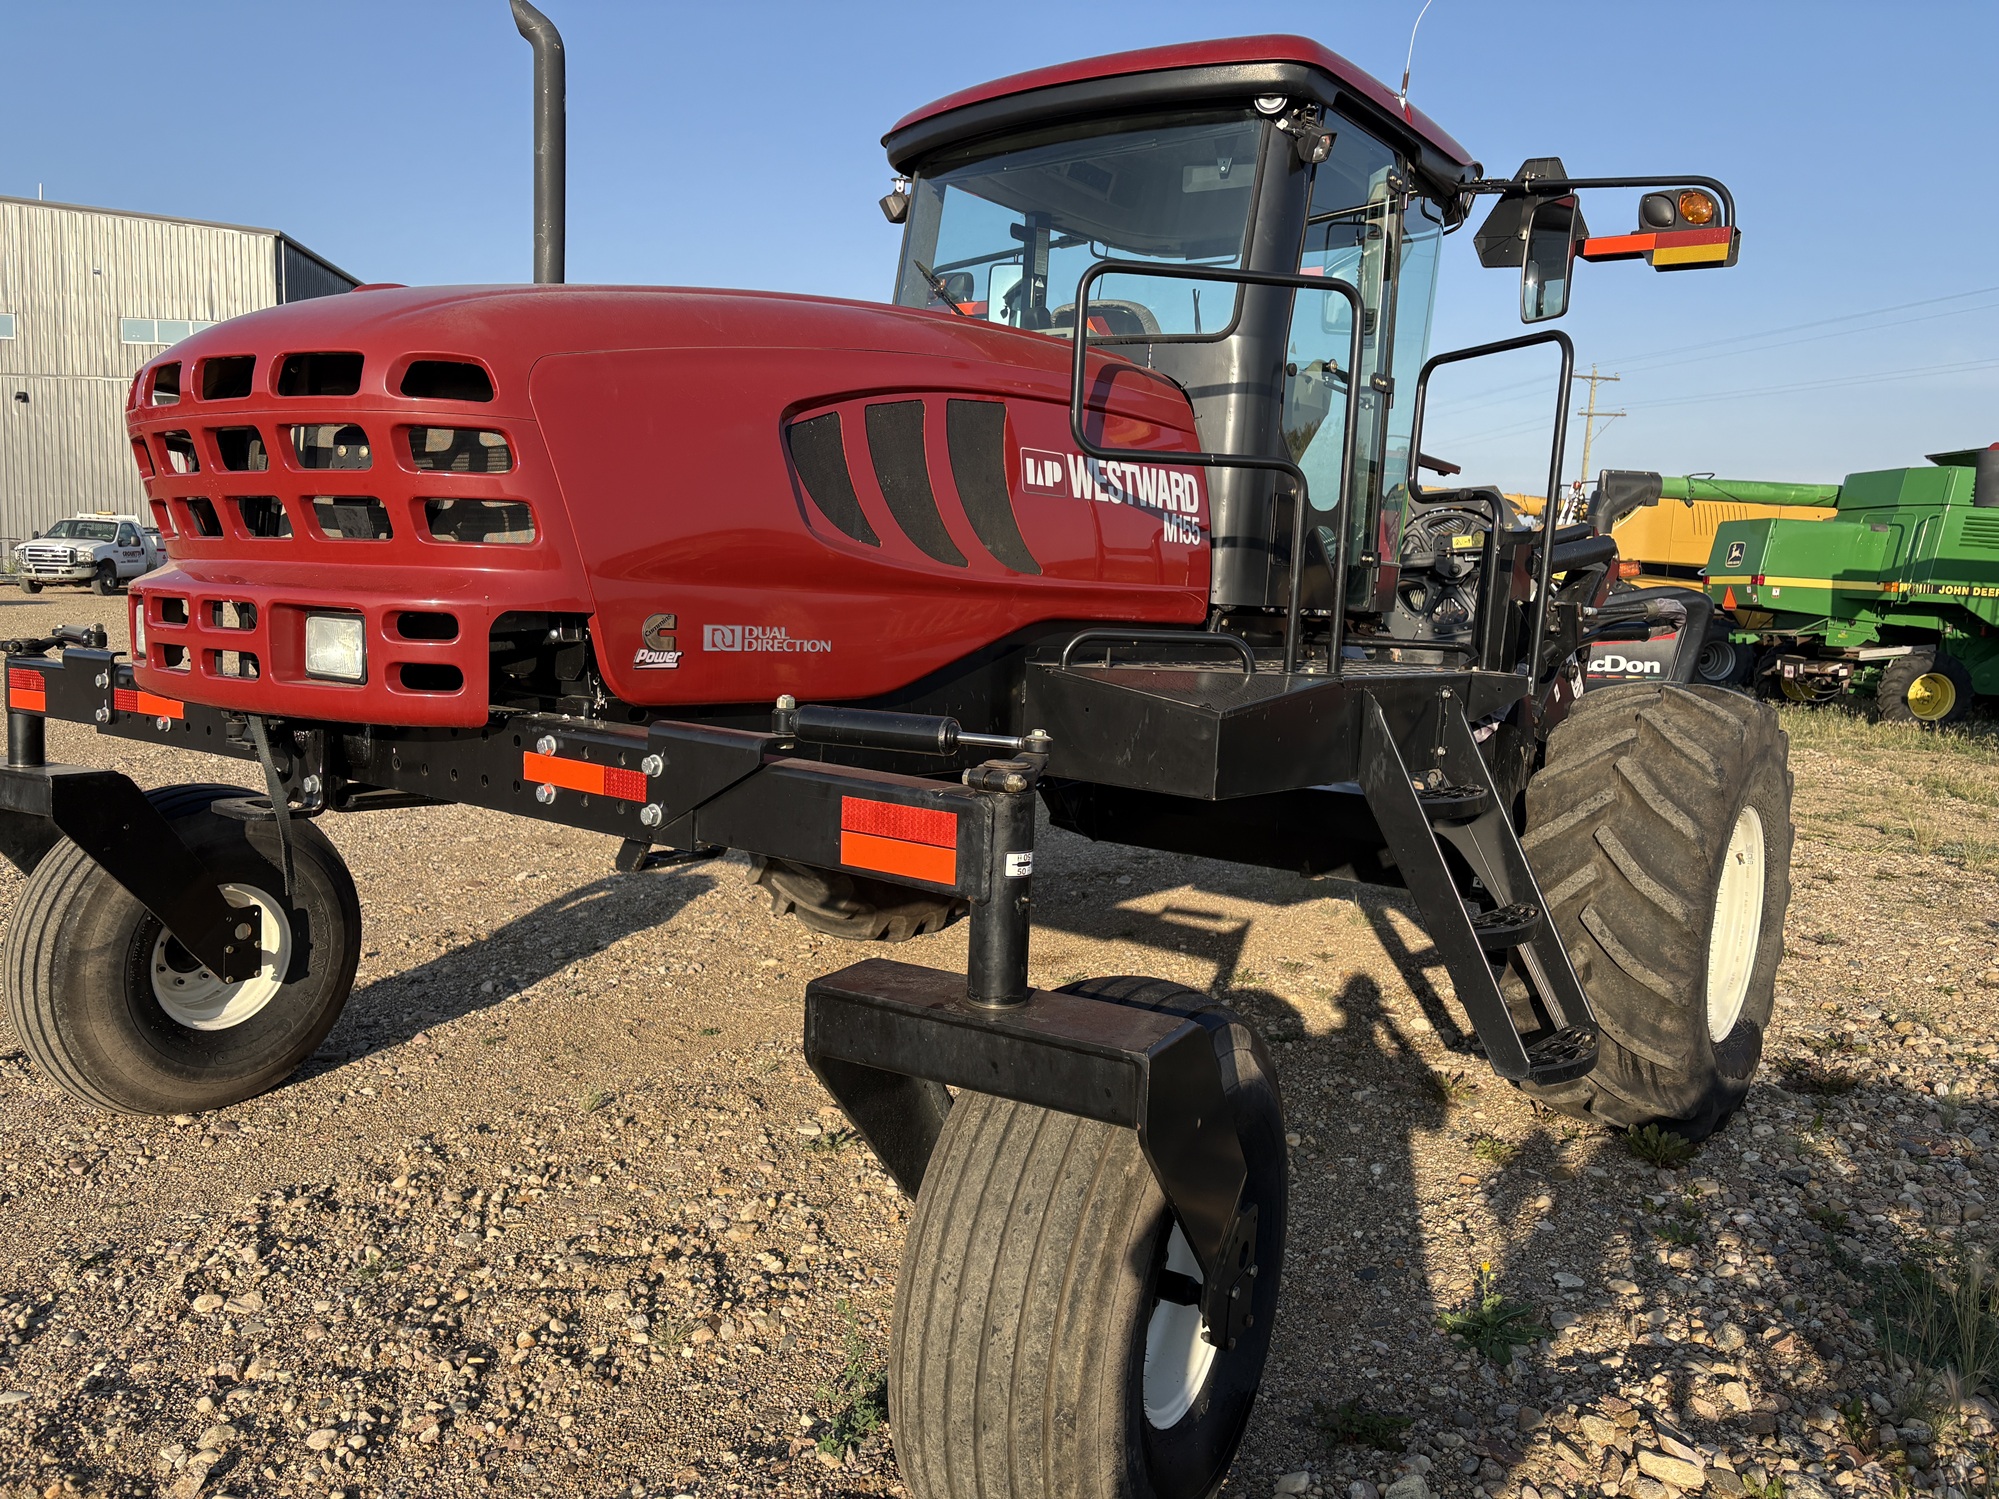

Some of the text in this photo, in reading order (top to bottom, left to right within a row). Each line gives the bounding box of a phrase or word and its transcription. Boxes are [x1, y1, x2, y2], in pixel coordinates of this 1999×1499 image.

[1066, 453, 1199, 513] WESTWARD
[1163, 511, 1200, 545] M155
[1938, 584, 1970, 596] JOHN
[645, 614, 673, 637] Cummins
[744, 625, 791, 639] DUAL
[743, 639, 832, 652] DIRECTION
[634, 648, 683, 664] Power
